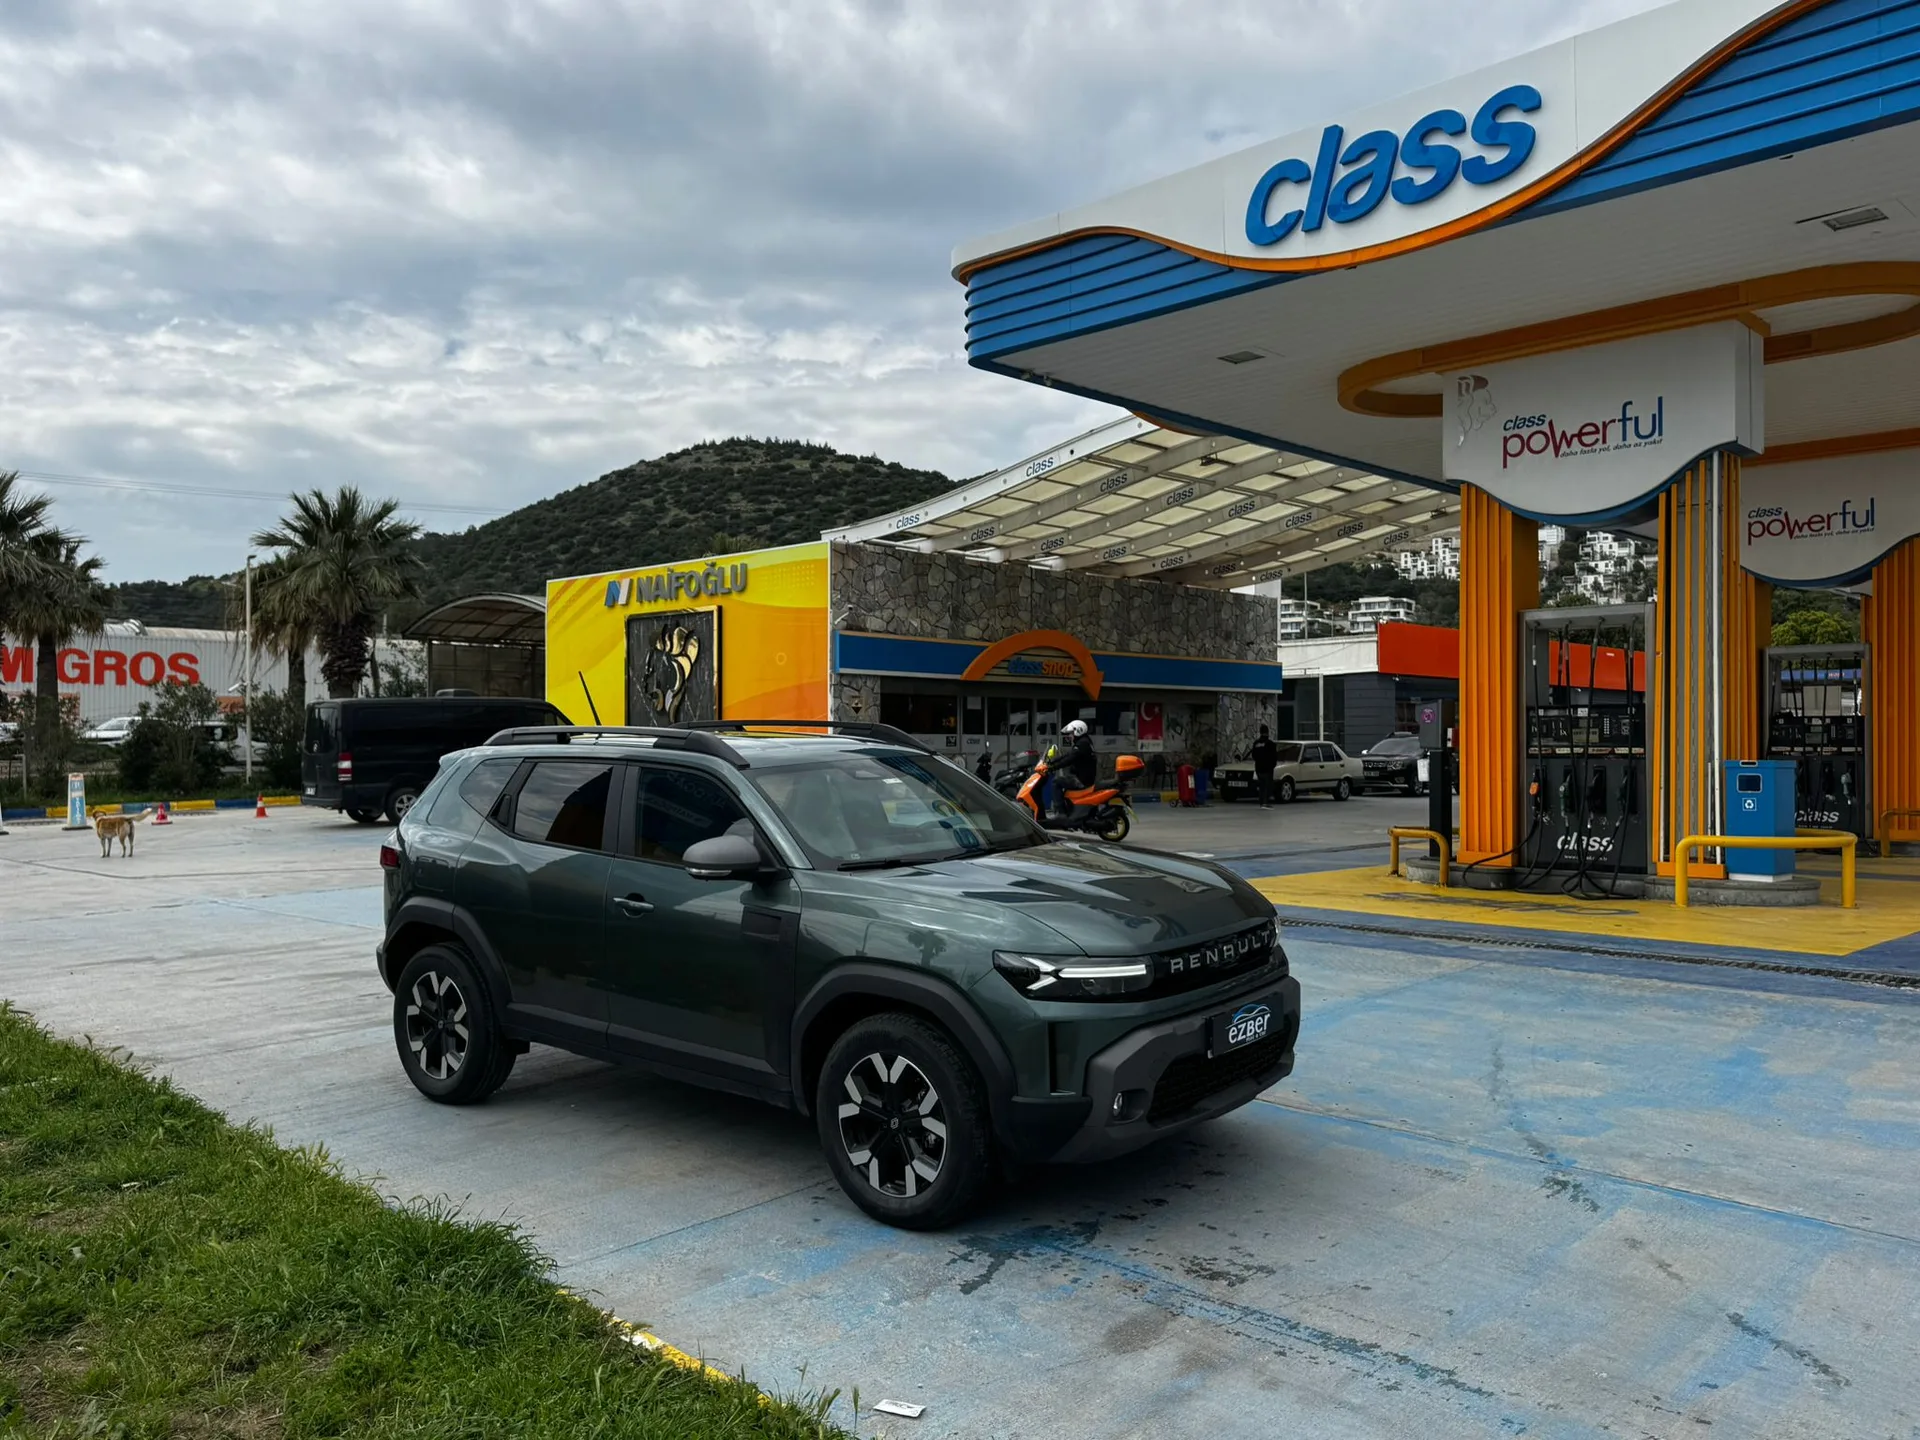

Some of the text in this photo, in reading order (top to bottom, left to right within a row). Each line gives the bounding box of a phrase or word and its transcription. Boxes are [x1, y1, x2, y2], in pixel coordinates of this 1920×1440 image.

[1245, 84, 1542, 246] class
[1503, 414, 1547, 432] class
[1502, 396, 1664, 469] powerful
[1026, 456, 1054, 478] class
[1100, 472, 1128, 493] class
[1166, 486, 1194, 506] class
[1228, 499, 1256, 518] class
[1748, 506, 1783, 519] class
[896, 513, 920, 529] class
[1285, 511, 1312, 529] class
[1747, 497, 1875, 546] powerful
[971, 525, 995, 542] class
[1337, 521, 1364, 538] class
[1383, 529, 1410, 545] class
[1041, 535, 1064, 552] class
[1103, 545, 1127, 560] class
[1160, 555, 1184, 570] class
[1212, 563, 1236, 576] class
[636, 561, 748, 603] NAİFOĞLU
[1259, 568, 1284, 582] class
[0, 646, 200, 687] MGROS
[1170, 930, 1270, 974] RENAULT
